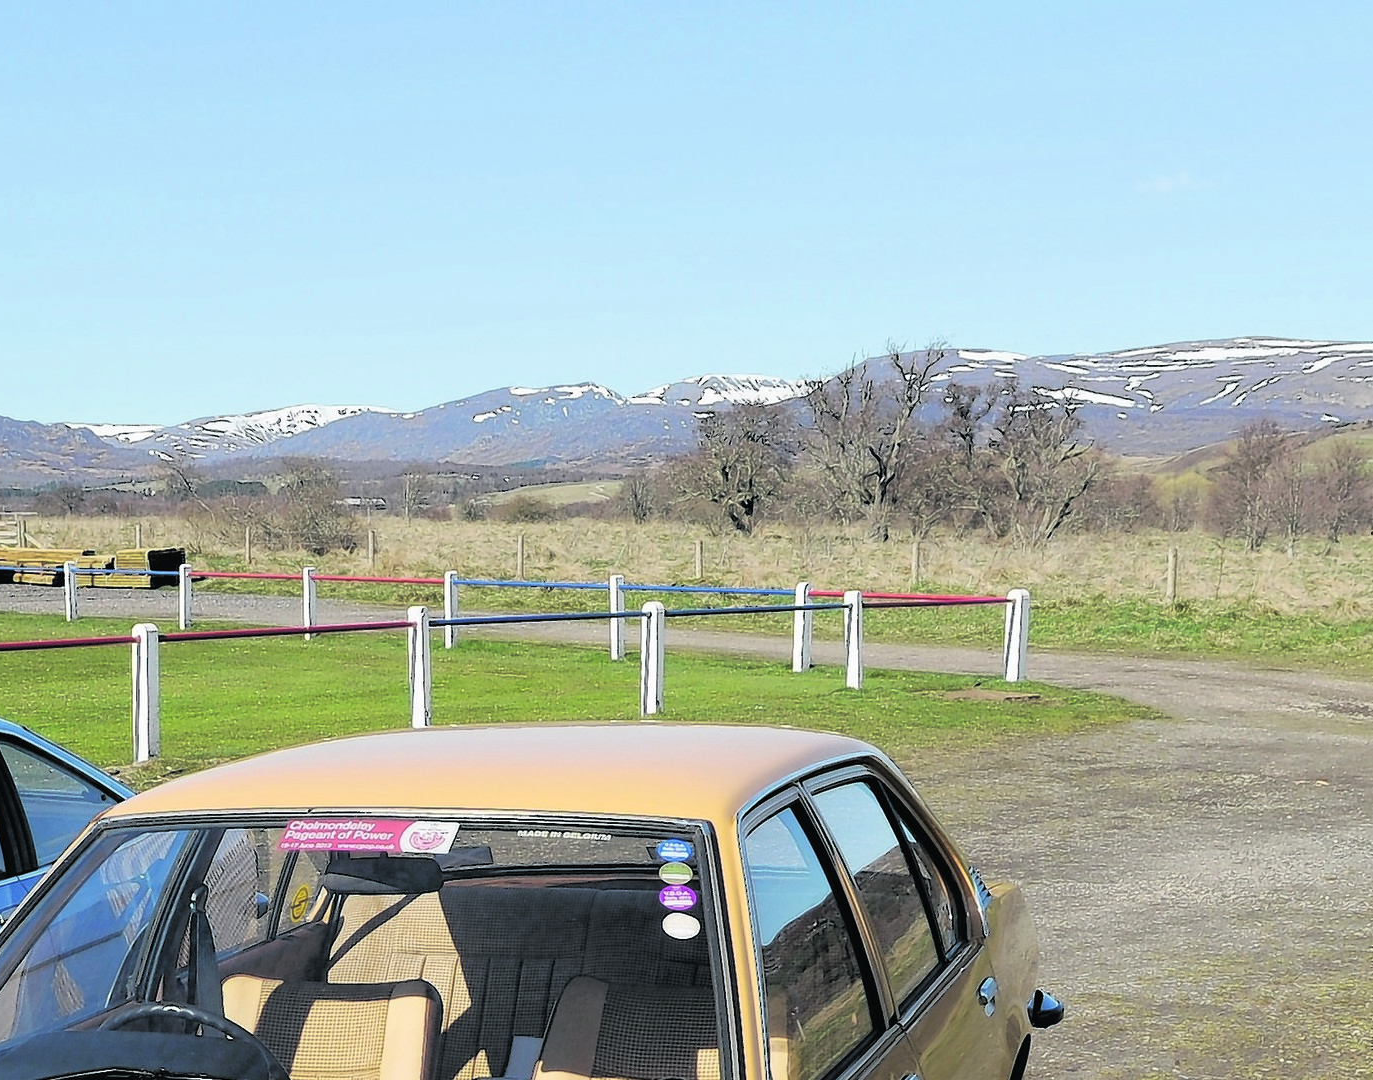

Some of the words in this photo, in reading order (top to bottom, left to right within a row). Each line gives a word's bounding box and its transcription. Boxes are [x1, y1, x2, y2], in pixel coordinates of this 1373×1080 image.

[289, 820, 376, 832] Cholmondeley
[284, 830, 337, 841] Pageant
[337, 830, 351, 840] of
[353, 831, 394, 840] Power
[517, 830, 549, 838] MADE
[563, 831, 612, 840] BELGIUM
